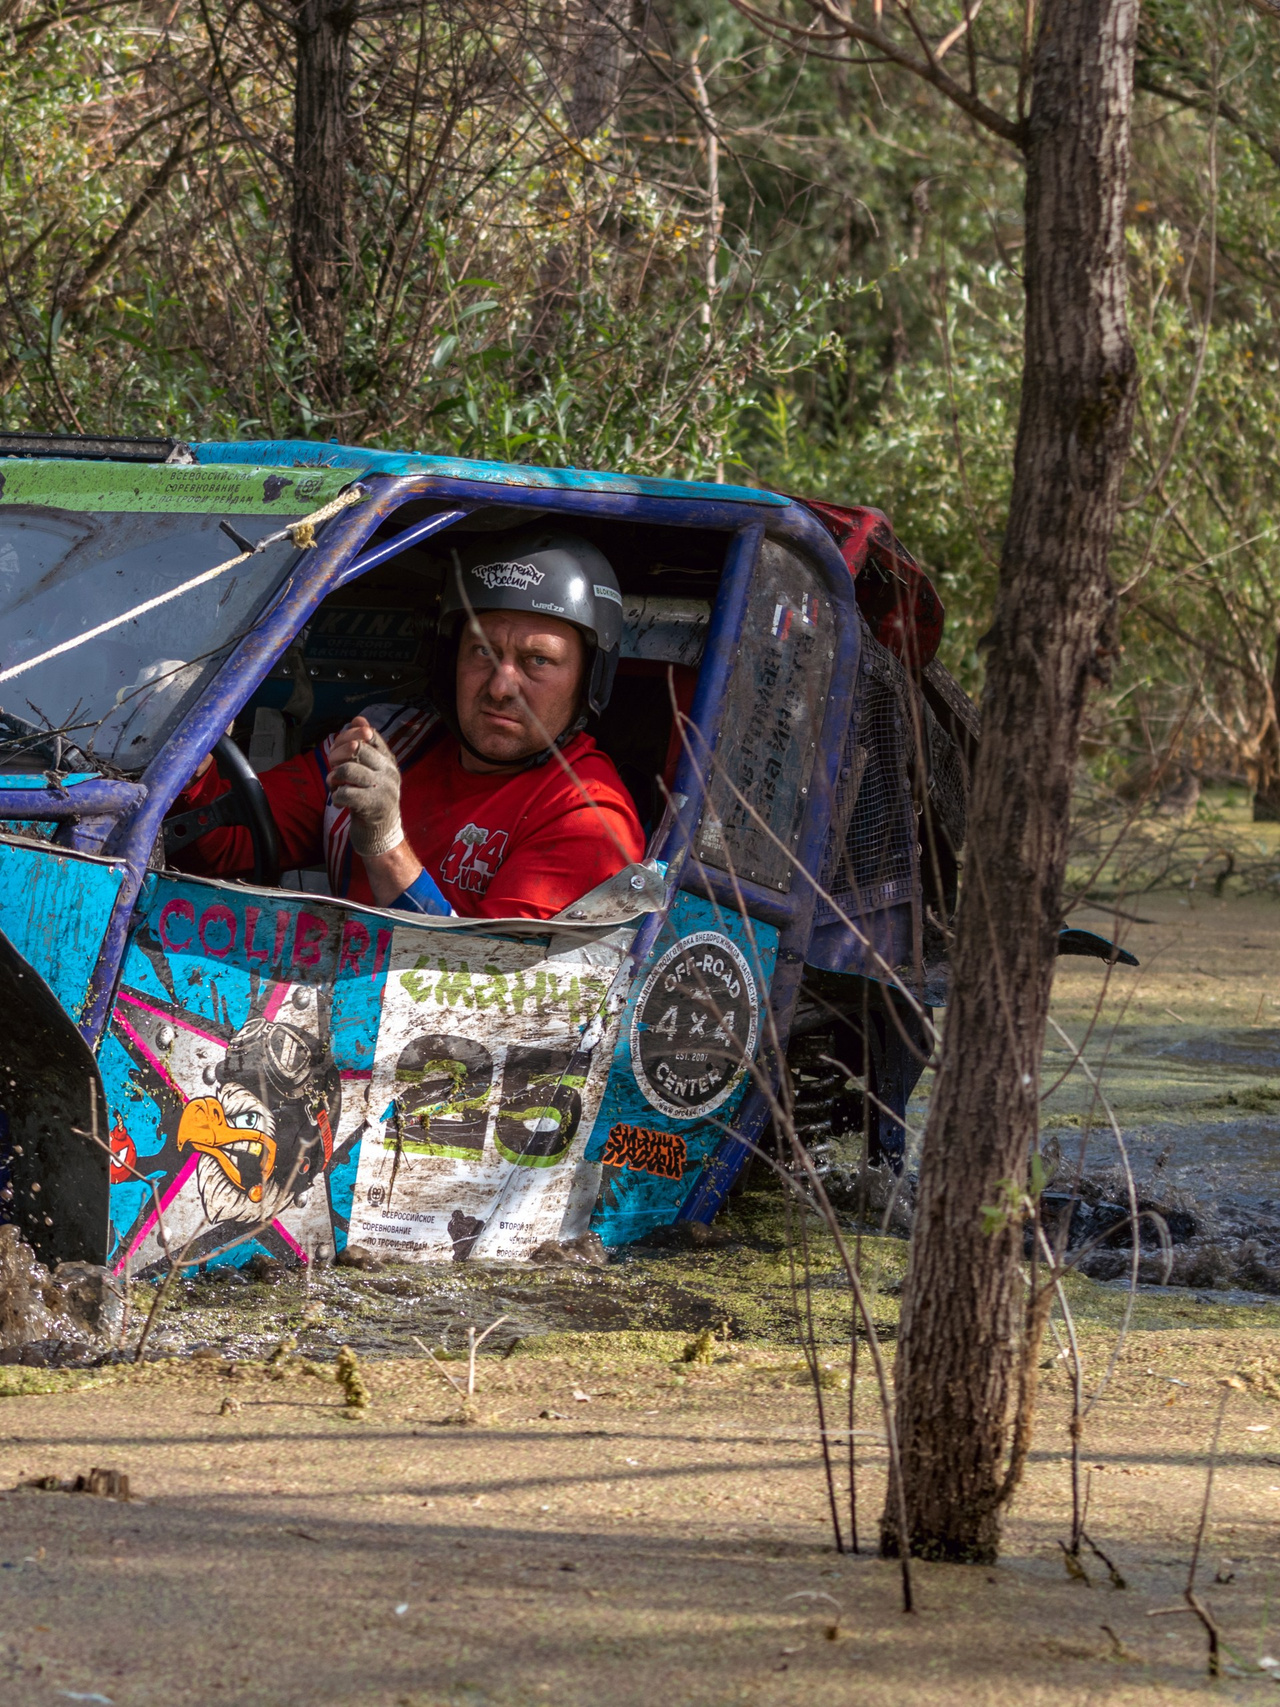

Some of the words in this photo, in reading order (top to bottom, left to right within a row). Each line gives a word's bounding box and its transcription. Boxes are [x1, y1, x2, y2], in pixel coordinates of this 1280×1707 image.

[170, 471, 252, 481] ВСЕРОССИЙСКОЕ
[165, 483, 241, 493] СОРЕВНОВАНИЕ
[158, 898, 394, 982] COLIBRI
[664, 954, 741, 999] OFF-ROAD
[656, 1062, 722, 1097] CENTER
[384, 1034, 591, 1167] 25
[381, 1210, 436, 1224] ВСЕРОССИЙСКОЕ
[362, 1222, 412, 1236] СОРЕВНОВАНИЕ
[366, 1236, 377, 1246] ПО
